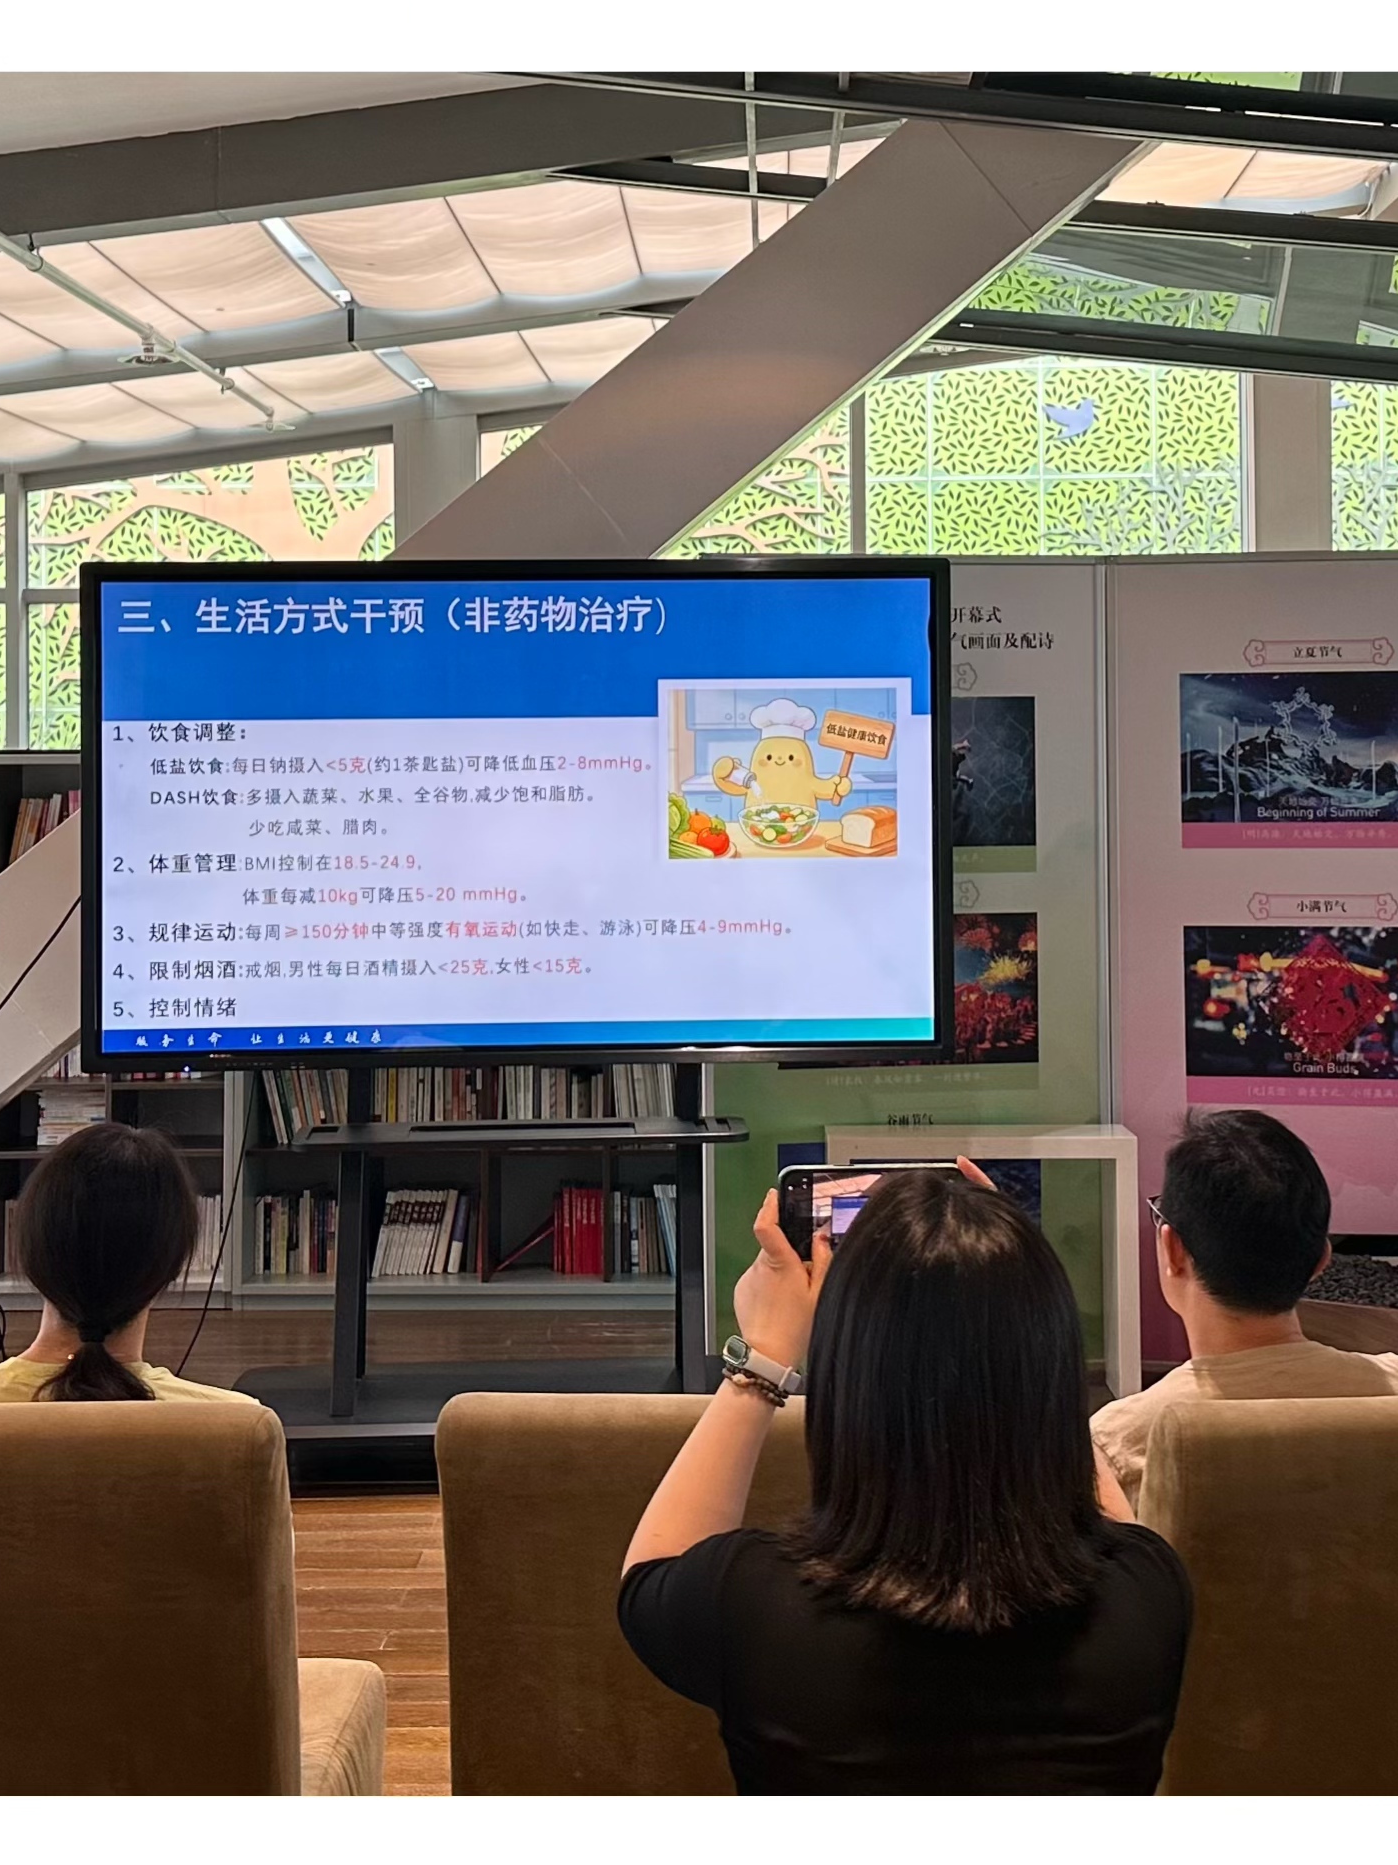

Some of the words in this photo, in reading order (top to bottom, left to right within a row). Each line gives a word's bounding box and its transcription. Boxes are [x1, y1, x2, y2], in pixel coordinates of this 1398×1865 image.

[118, 594, 669, 637] 三、生活方式干预（非药物治疗）
[951, 606, 1002, 623] 开幕式
[1294, 645, 1343, 659] 立夏节气
[825, 722, 888, 747] 低盐健康饮食
[1257, 807, 1314, 822] Beginning
[1316, 807, 1324, 818] of
[1325, 807, 1381, 818] Summer
[249, 816, 389, 838] 少吃咸菜、腊肉。
[1296, 900, 1348, 914] 小满节气
[113, 996, 238, 1019] 5、控制情绪
[134, 1031, 223, 1049] 服务生命
[249, 1029, 385, 1048] 让生活更健康
[1293, 1061, 1324, 1075] Grain
[1326, 1061, 1356, 1075] Buds
